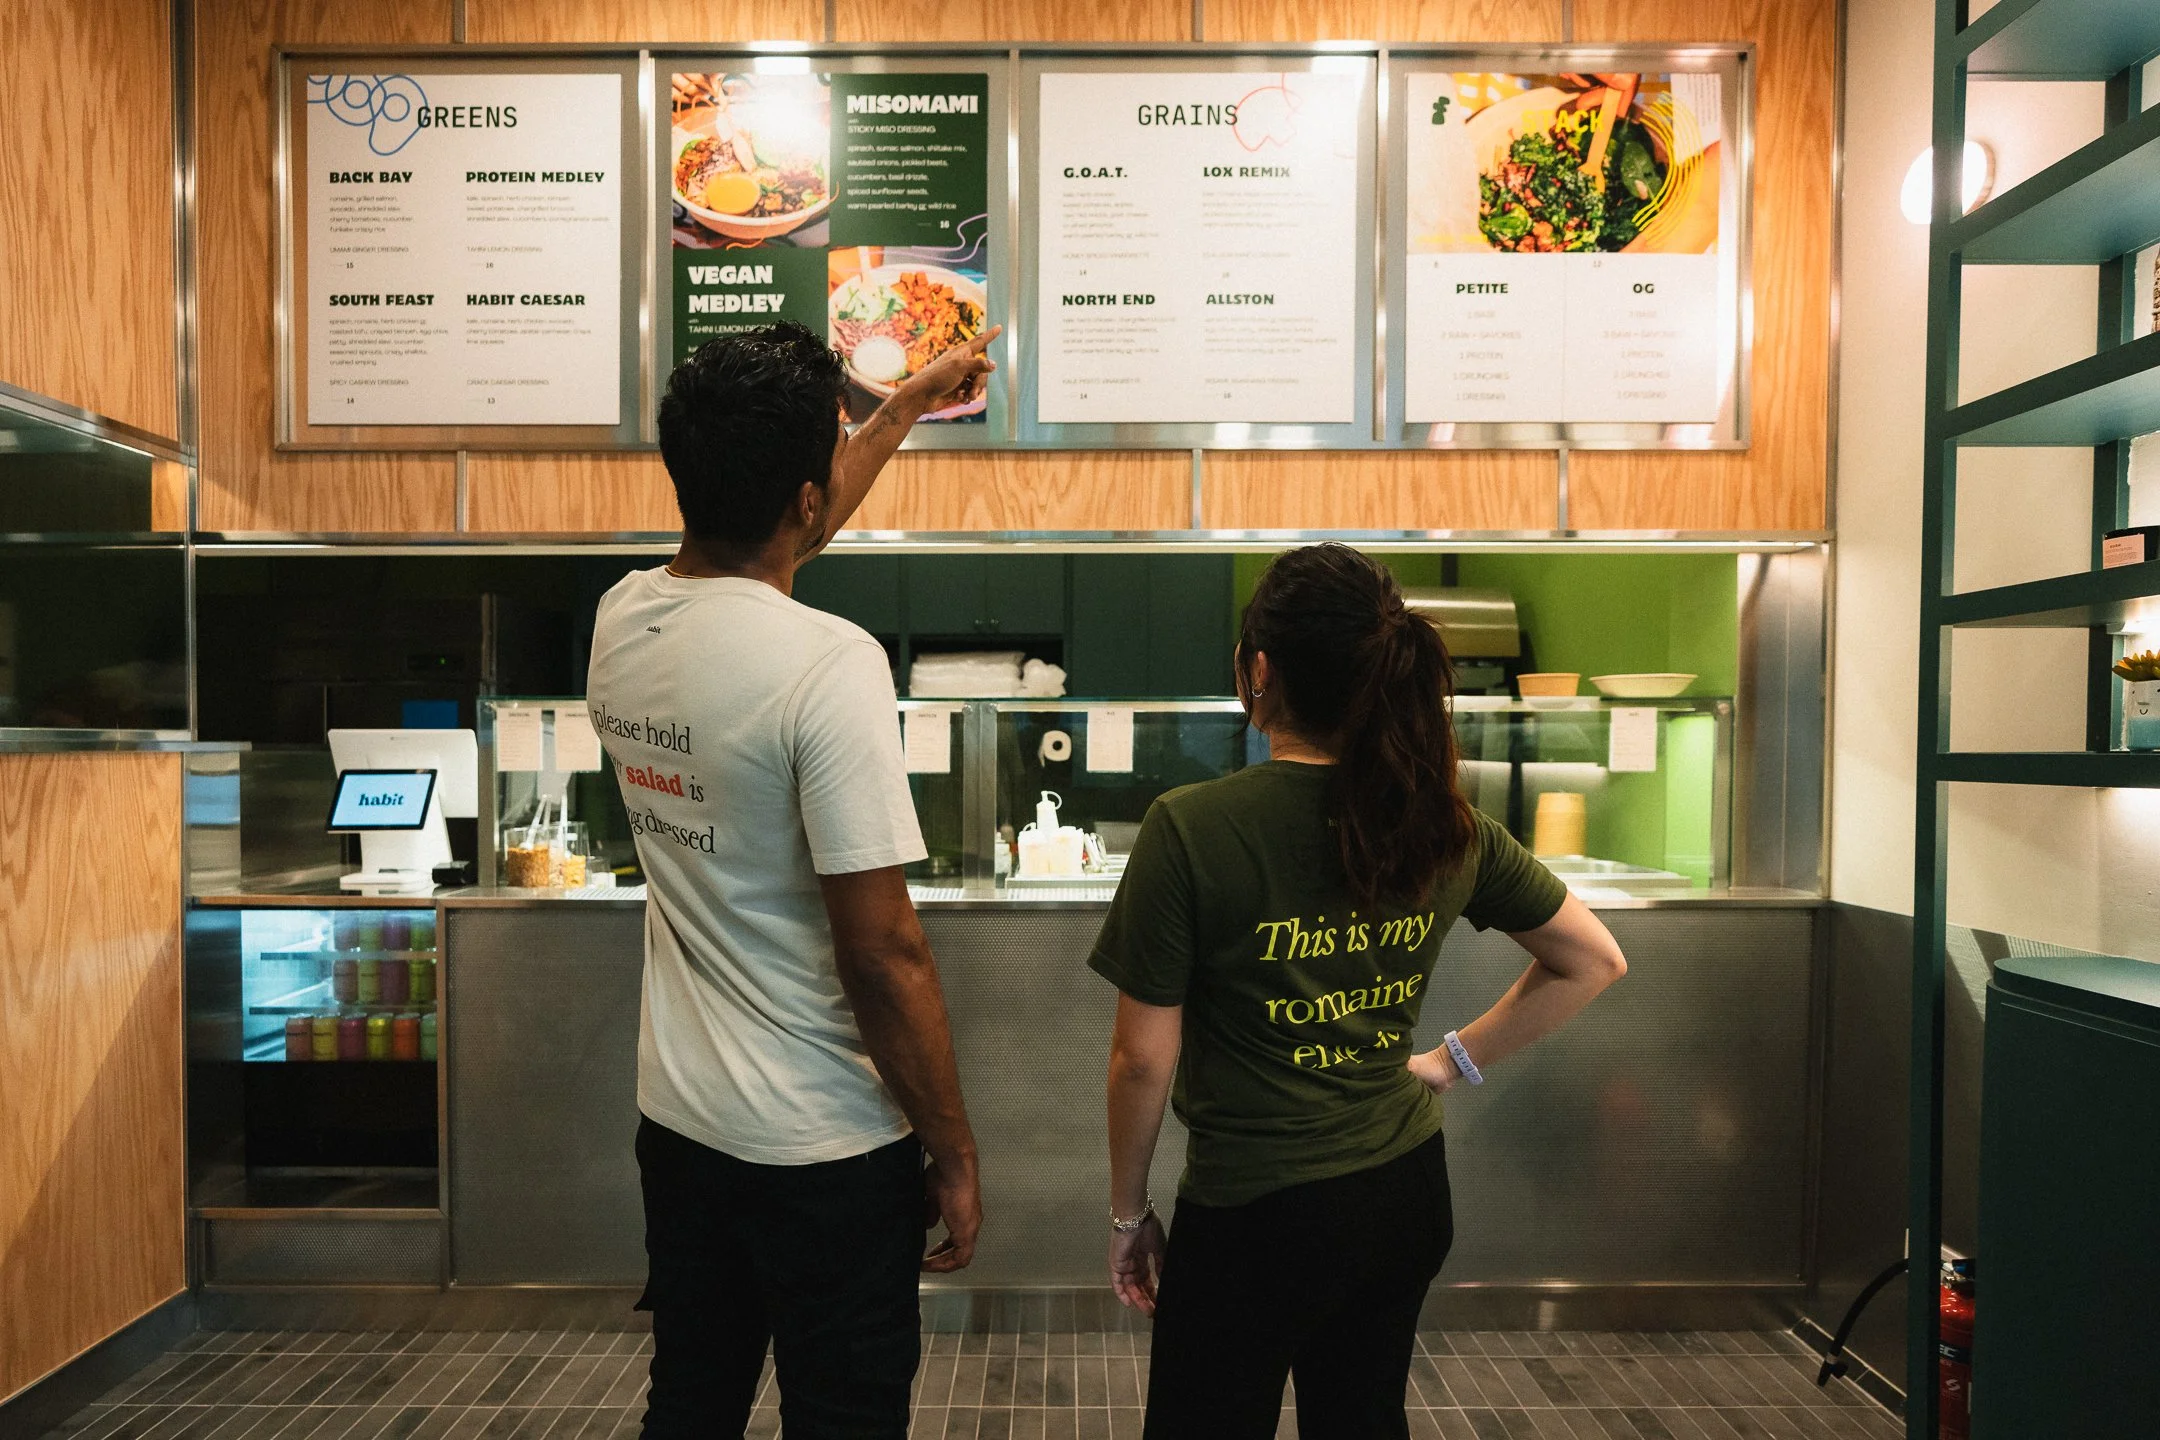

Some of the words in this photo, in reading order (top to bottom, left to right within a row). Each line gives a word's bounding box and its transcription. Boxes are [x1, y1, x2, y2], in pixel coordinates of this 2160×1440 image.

[847, 94, 978, 114] MISOMAMI
[417, 106, 518, 129] GREENS
[1138, 104, 1238, 127] GRAINS
[1521, 110, 1604, 133] STACK
[848, 125, 875, 134] STICKY
[876, 125, 896, 134] MISO
[897, 125, 936, 134] DRESSING
[329, 171, 374, 184] BACK
[379, 171, 413, 184] BAY
[466, 171, 535, 184] PROTEIN
[541, 171, 605, 184] MEDLEY
[1063, 166, 1128, 179] G.O.A.T.
[1203, 166, 1233, 178] LOX
[1239, 166, 1291, 178] REMIX
[688, 265, 773, 285] VEGAN
[1456, 283, 1509, 294] PETITE
[1633, 283, 1655, 294] OG
[329, 294, 380, 306] SOUTH
[386, 294, 434, 306] FEAST
[467, 294, 515, 306] HABIT
[520, 294, 586, 306] CAESAR
[688, 294, 785, 313] MEDLEY
[1062, 294, 1117, 306] NORTH
[1123, 294, 1156, 306] END
[1206, 294, 1275, 305] ALLSTON
[688, 325, 713, 334] TAHINI
[714, 325, 744, 334] LEMON
[594, 704, 641, 741] please
[646, 717, 692, 755] hold
[626, 765, 685, 797] salad
[689, 775, 704, 803] is
[358, 793, 404, 807] habit
[646, 809, 716, 854] dressed
[1256, 916, 1337, 961] This
[1346, 911, 1370, 953] is
[1379, 911, 1434, 952] my
[1266, 974, 1423, 1025] romaine
